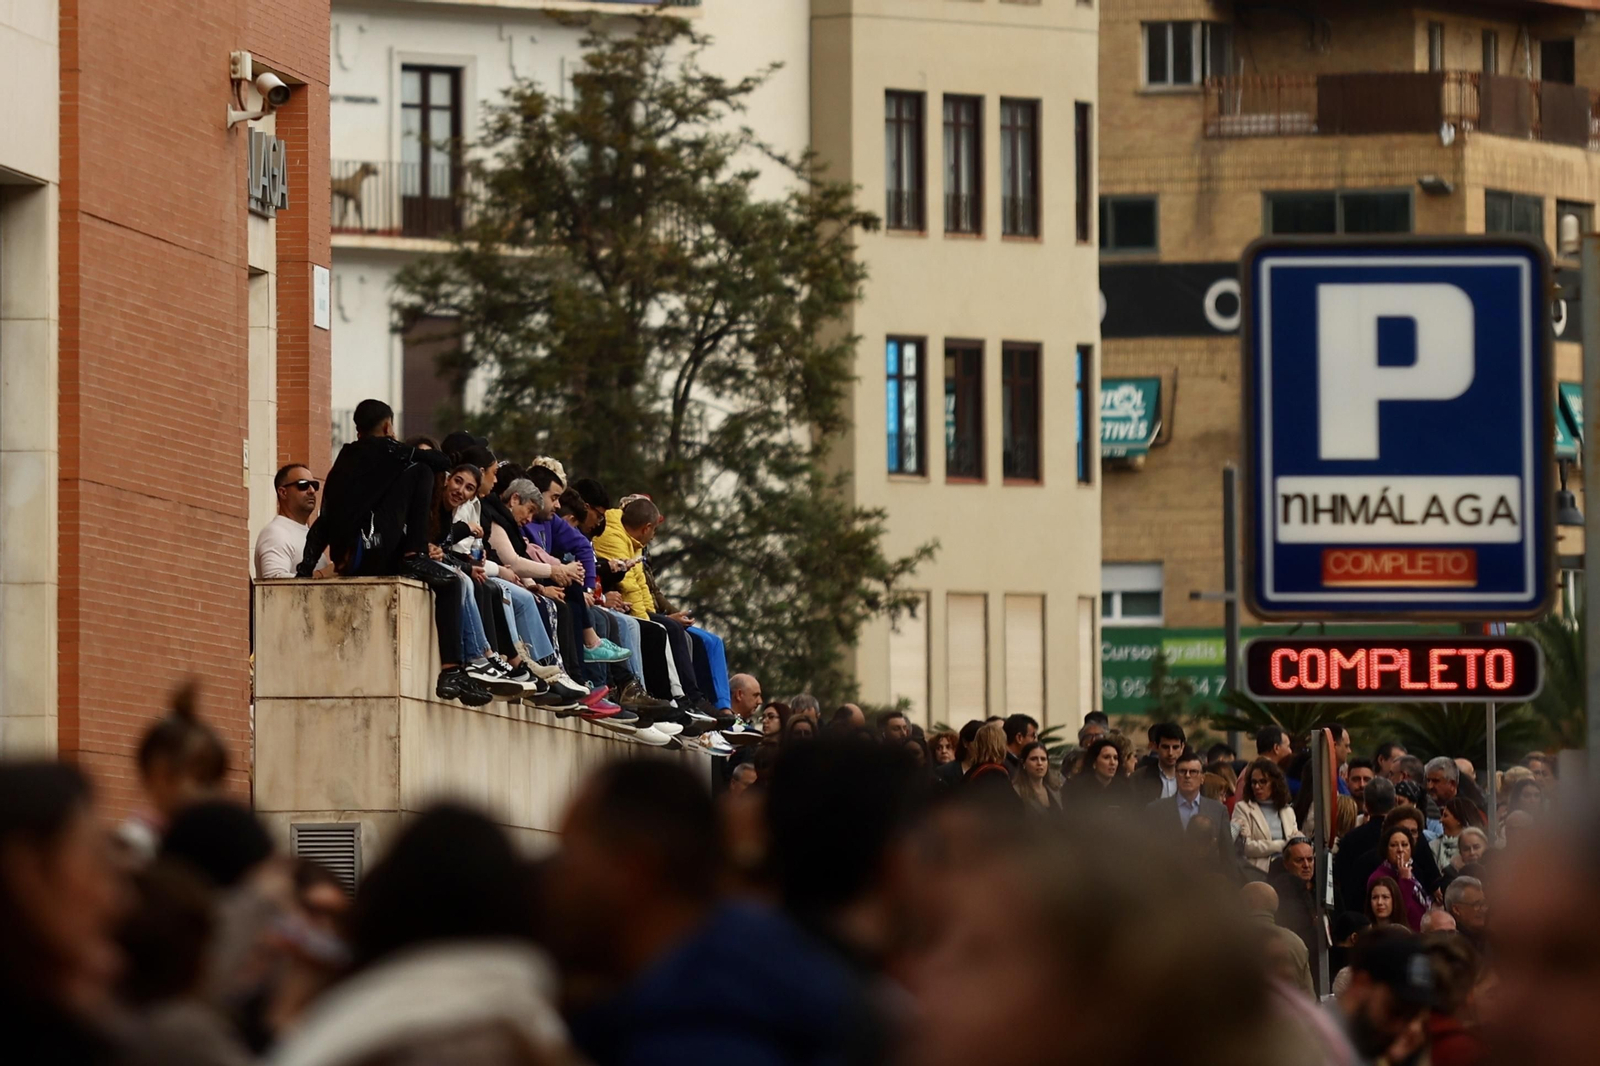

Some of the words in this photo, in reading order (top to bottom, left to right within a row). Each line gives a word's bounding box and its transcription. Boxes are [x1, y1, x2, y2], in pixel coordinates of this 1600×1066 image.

[248, 127, 288, 210] LAGA
[1316, 282, 1475, 461] P
[1327, 551, 1469, 575] COMPLETO
[1166, 641, 1216, 665] gratis
[1270, 647, 1515, 690] COMPLETO
